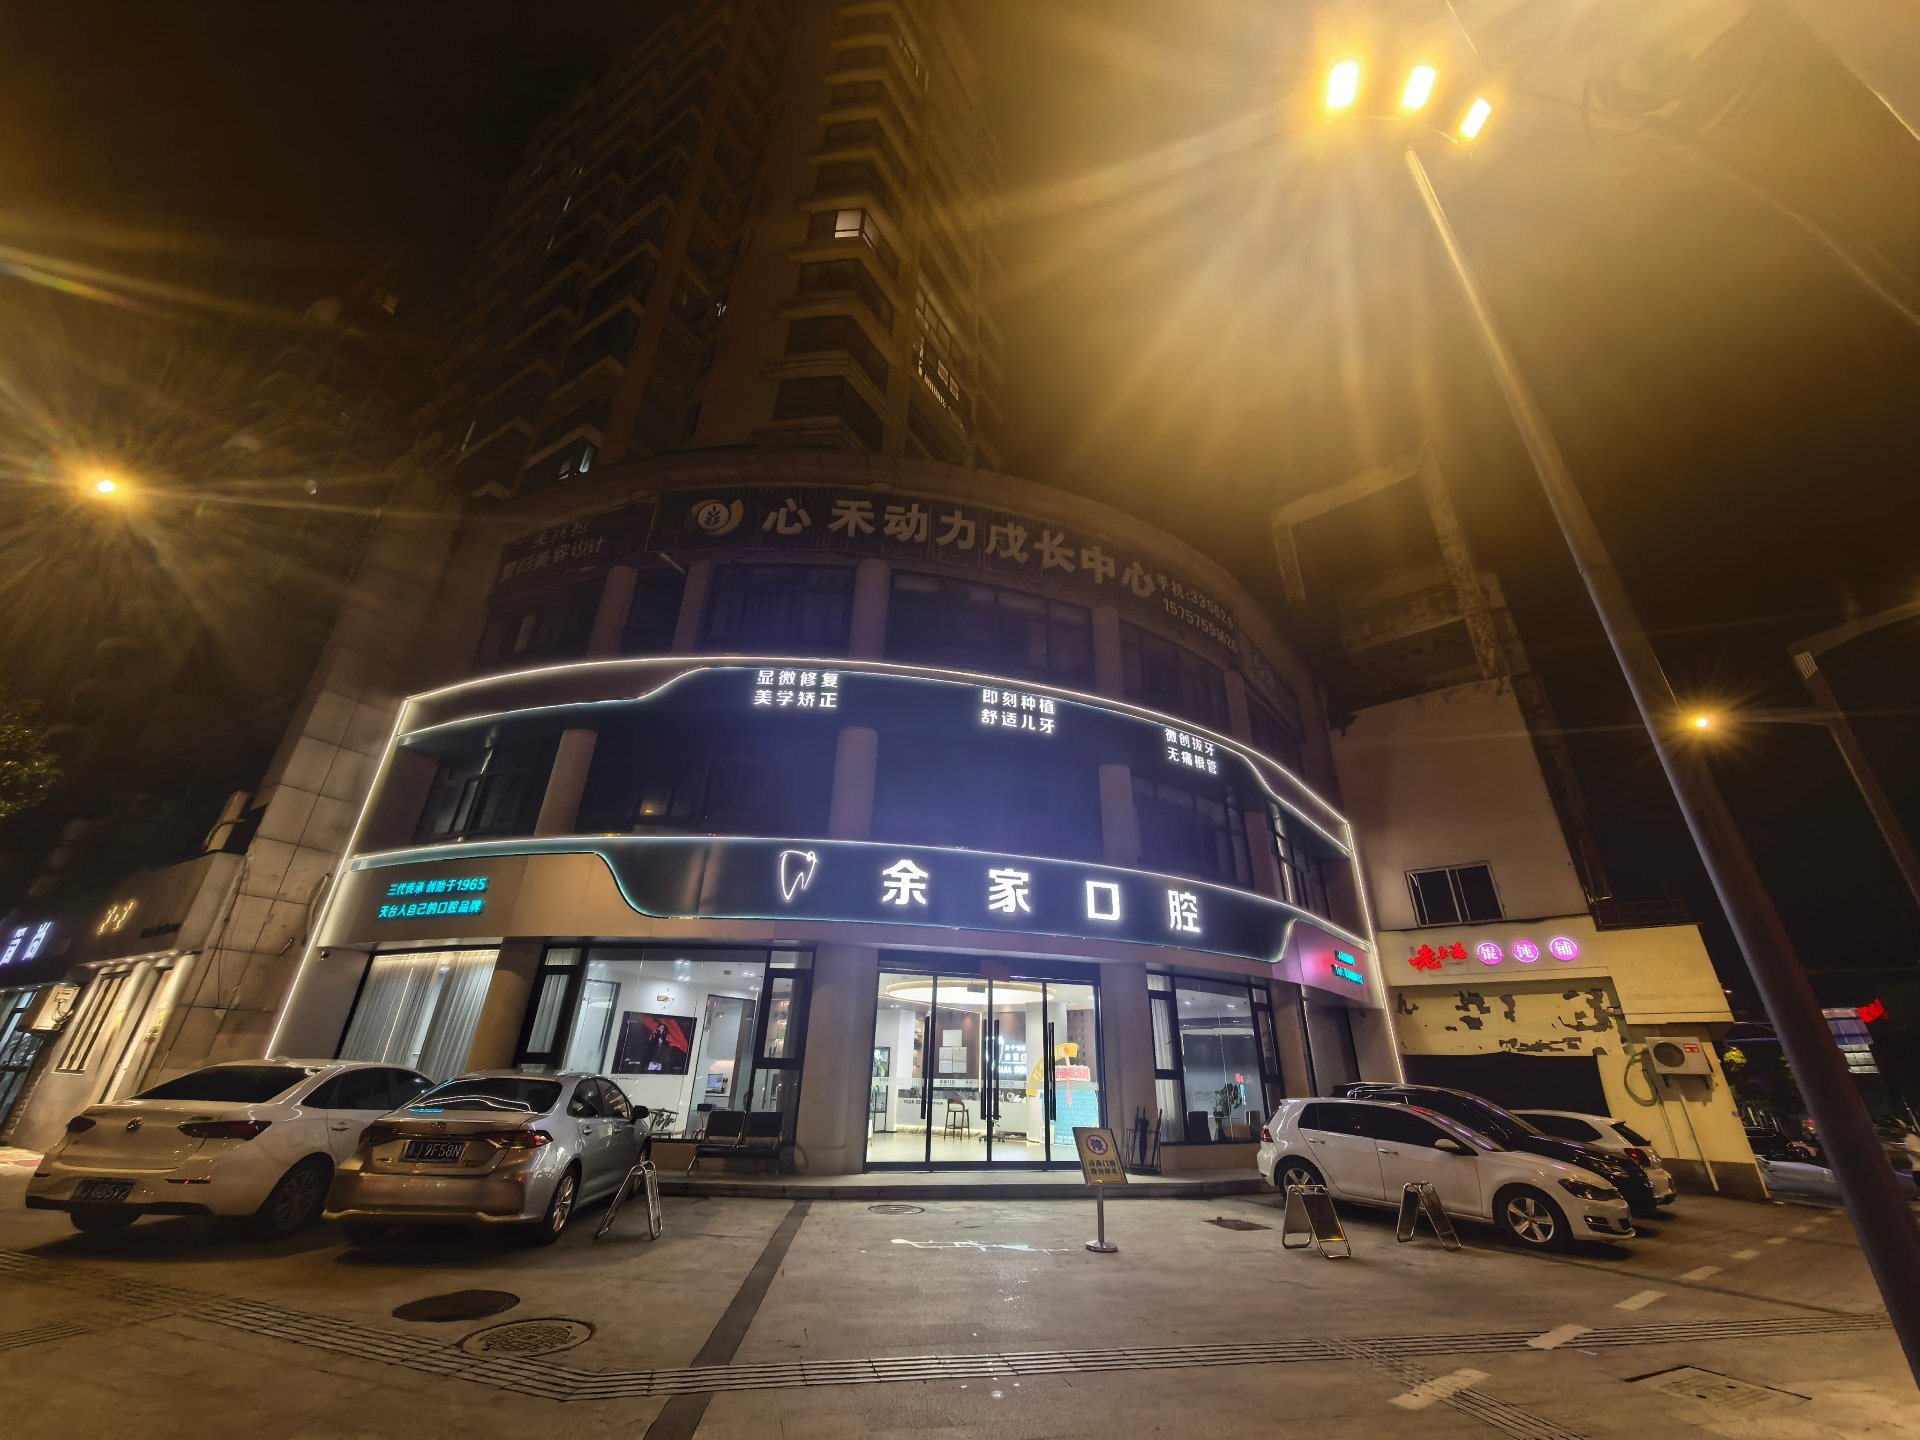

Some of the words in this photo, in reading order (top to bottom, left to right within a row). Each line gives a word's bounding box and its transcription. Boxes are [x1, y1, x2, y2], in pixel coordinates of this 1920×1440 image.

[761, 497, 1156, 598] 心禾动力成长中心
[755, 669, 839, 688] 显微修复
[753, 689, 838, 708] 美学矫正
[981, 688, 1056, 715] 即刻种植
[980, 708, 1055, 734] 舒适儿牙
[1164, 727, 1215, 757] 微创拔牙
[1167, 746, 1217, 775] 无痛根管
[377, 898, 485, 919] 天台人自己的口腔品牌
[881, 857, 1202, 935] 余家口腔
[1478, 938, 1576, 964] 馄饨铺
